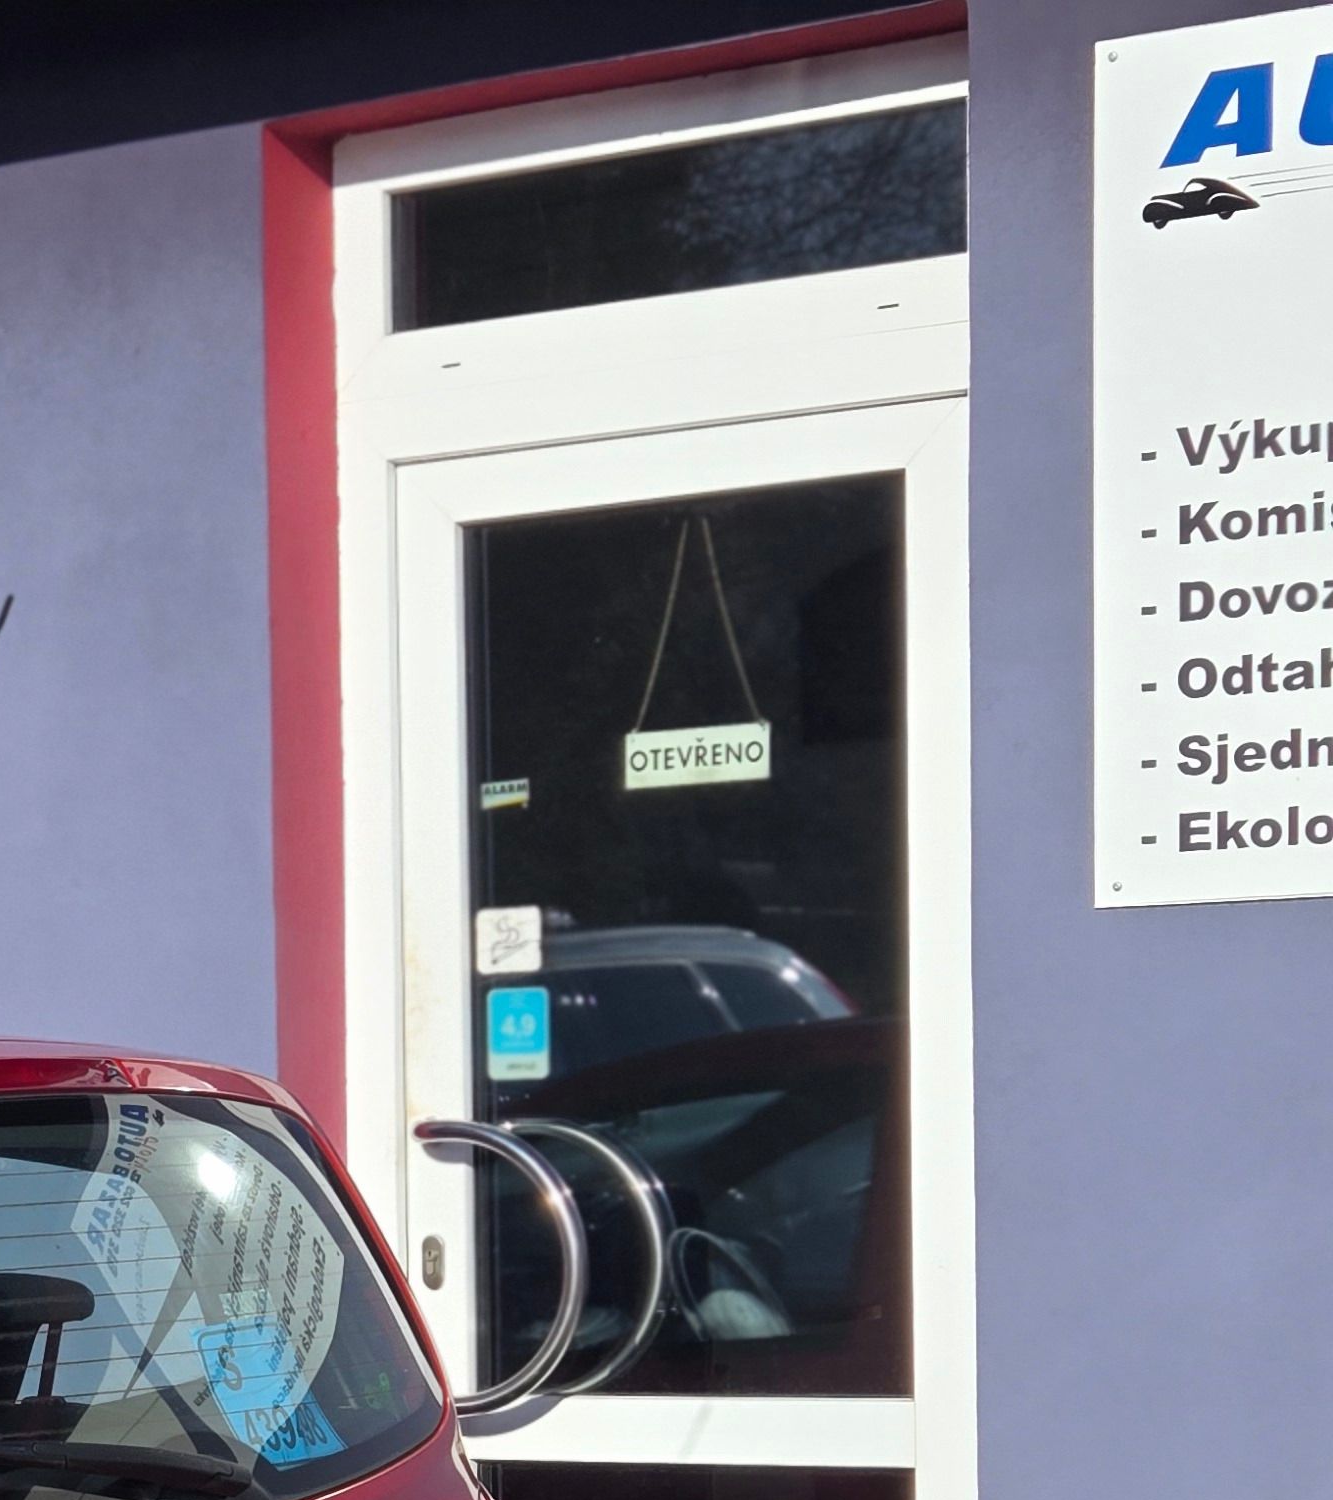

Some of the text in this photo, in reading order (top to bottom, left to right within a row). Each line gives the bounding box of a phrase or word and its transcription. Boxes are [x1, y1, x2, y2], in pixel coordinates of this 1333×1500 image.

[1176, 418, 1333, 474] Výku
[1179, 490, 1333, 544] Komi
[629, 737, 764, 772] OTEVŘENO
[1177, 728, 1333, 785] Sjedn
[1179, 806, 1333, 852] Ekolo
